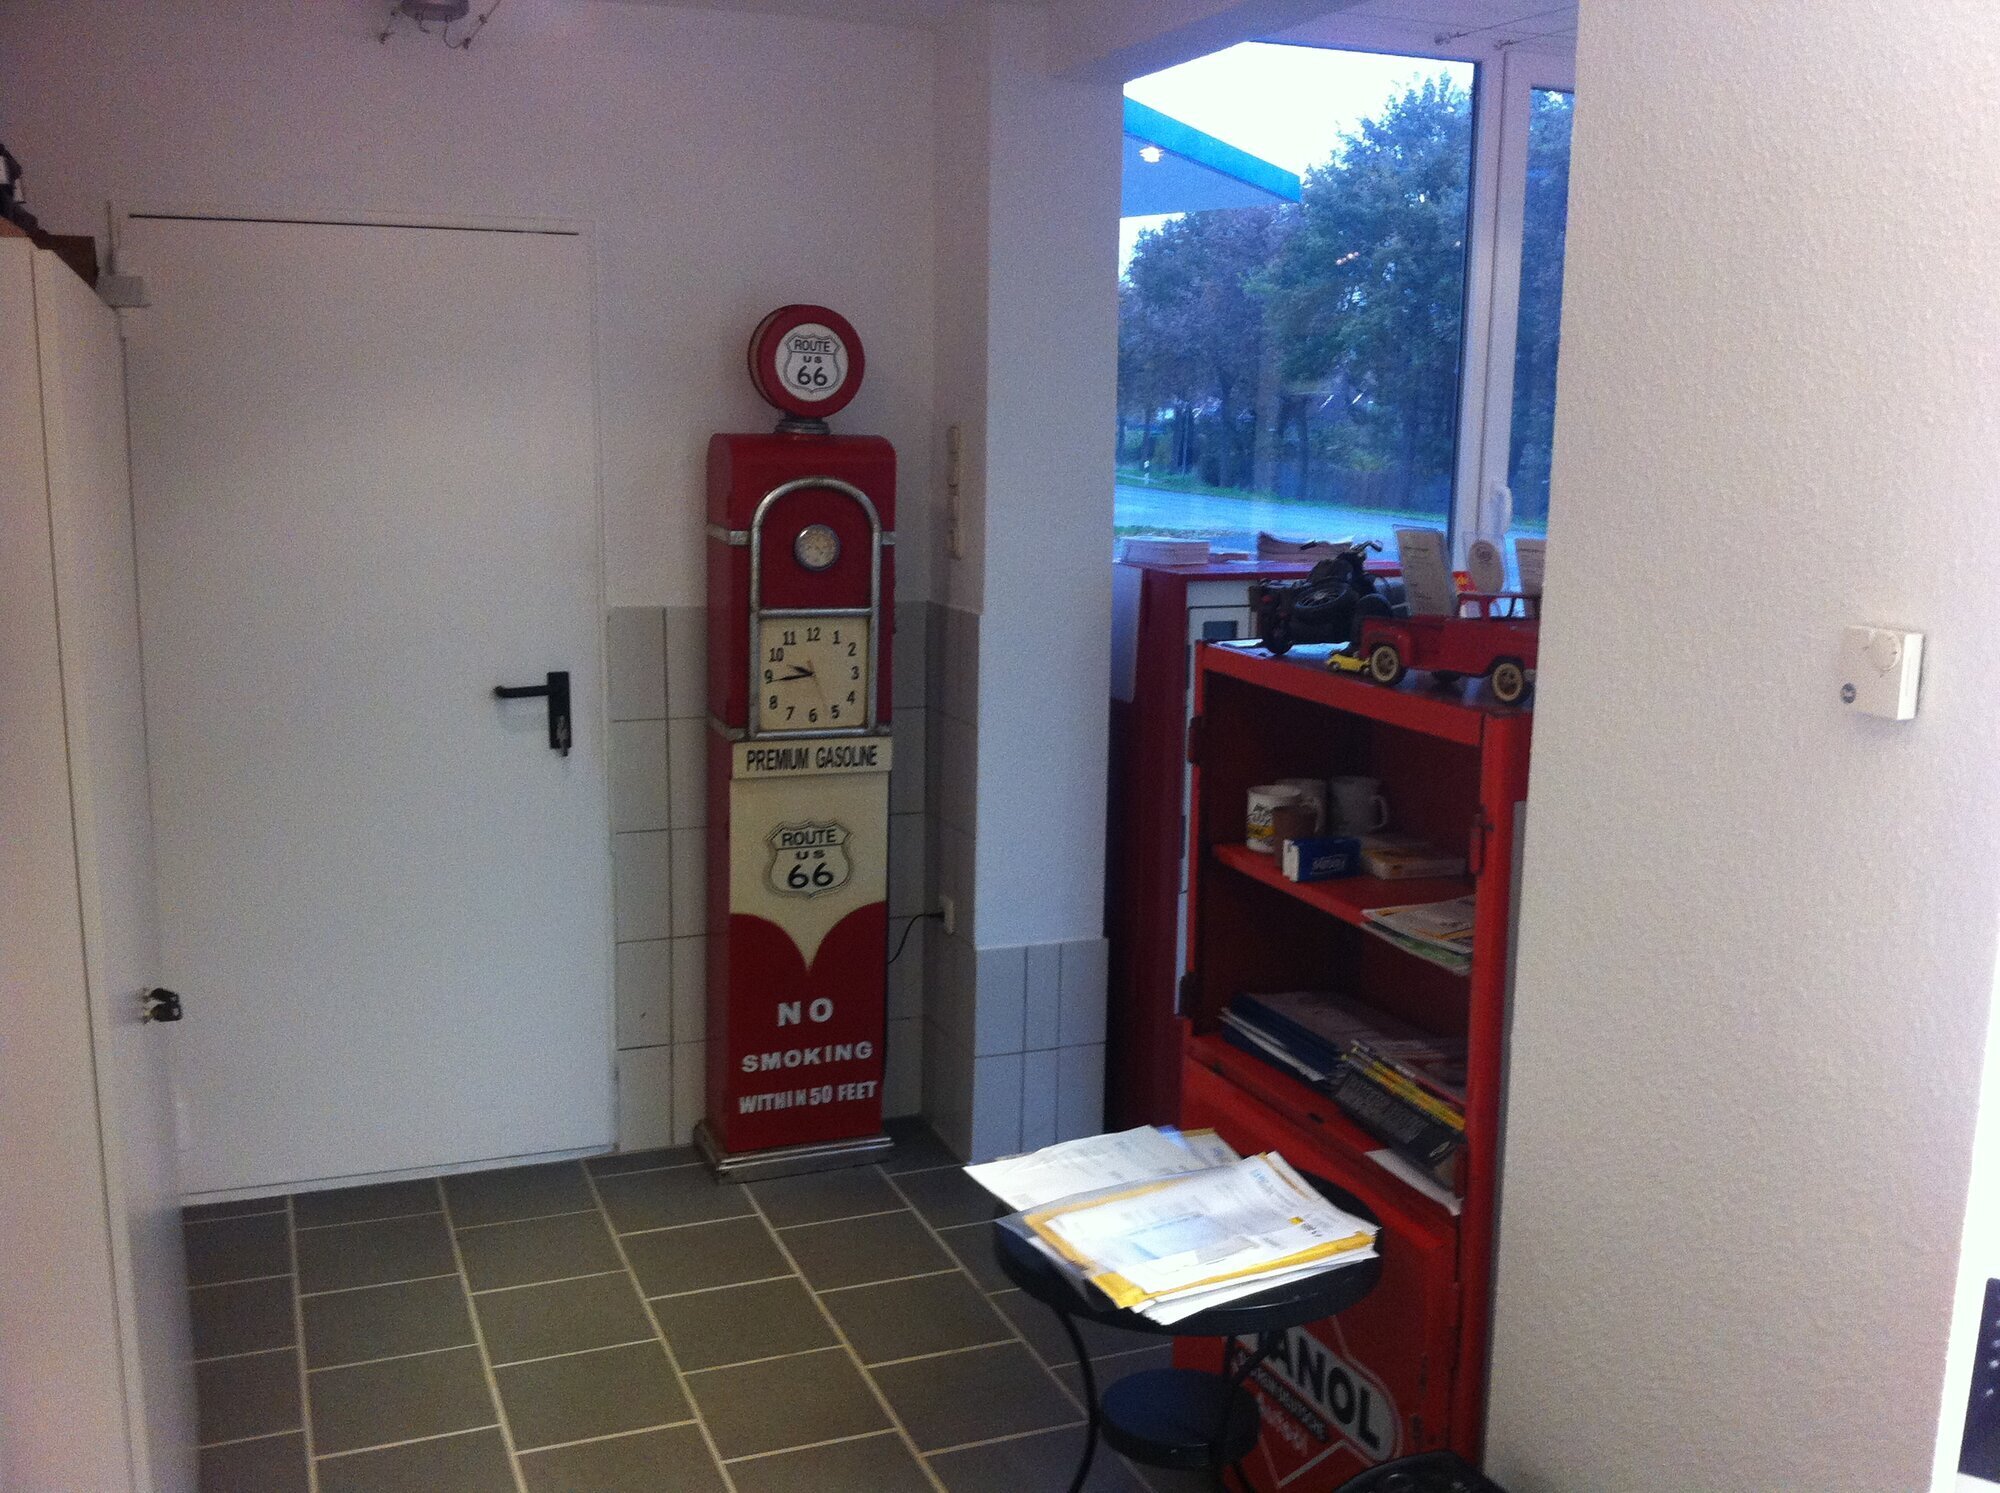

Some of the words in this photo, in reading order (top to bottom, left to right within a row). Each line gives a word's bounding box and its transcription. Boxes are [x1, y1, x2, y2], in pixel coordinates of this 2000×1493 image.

[794, 339, 831, 352] ROUTE
[803, 355, 822, 363] US
[797, 366, 828, 386] 66
[783, 631, 796, 646] 11
[806, 627, 821, 642] 12
[833, 631, 841, 645] 1
[769, 647, 784, 662] 10
[848, 642, 857, 657] 2
[764, 669, 774, 684] 9
[851, 666, 860, 680] 3
[769, 695, 778, 710] 8
[847, 691, 856, 705] 4
[785, 707, 795, 720] 7
[809, 708, 818, 723] 6
[830, 705, 840, 719] 5
[746, 747, 809, 772] PREMIUM
[816, 745, 878, 769] GASOLINE
[781, 828, 838, 847] ROUTE
[795, 849, 825, 860] US
[787, 863, 834, 889] 66
[777, 998, 834, 1028] NO
[741, 1040, 873, 1073] SMOKING
[738, 1088, 807, 1115] WITHIN
[810, 1085, 833, 1107] 50
[837, 1080, 878, 1102] FEET
